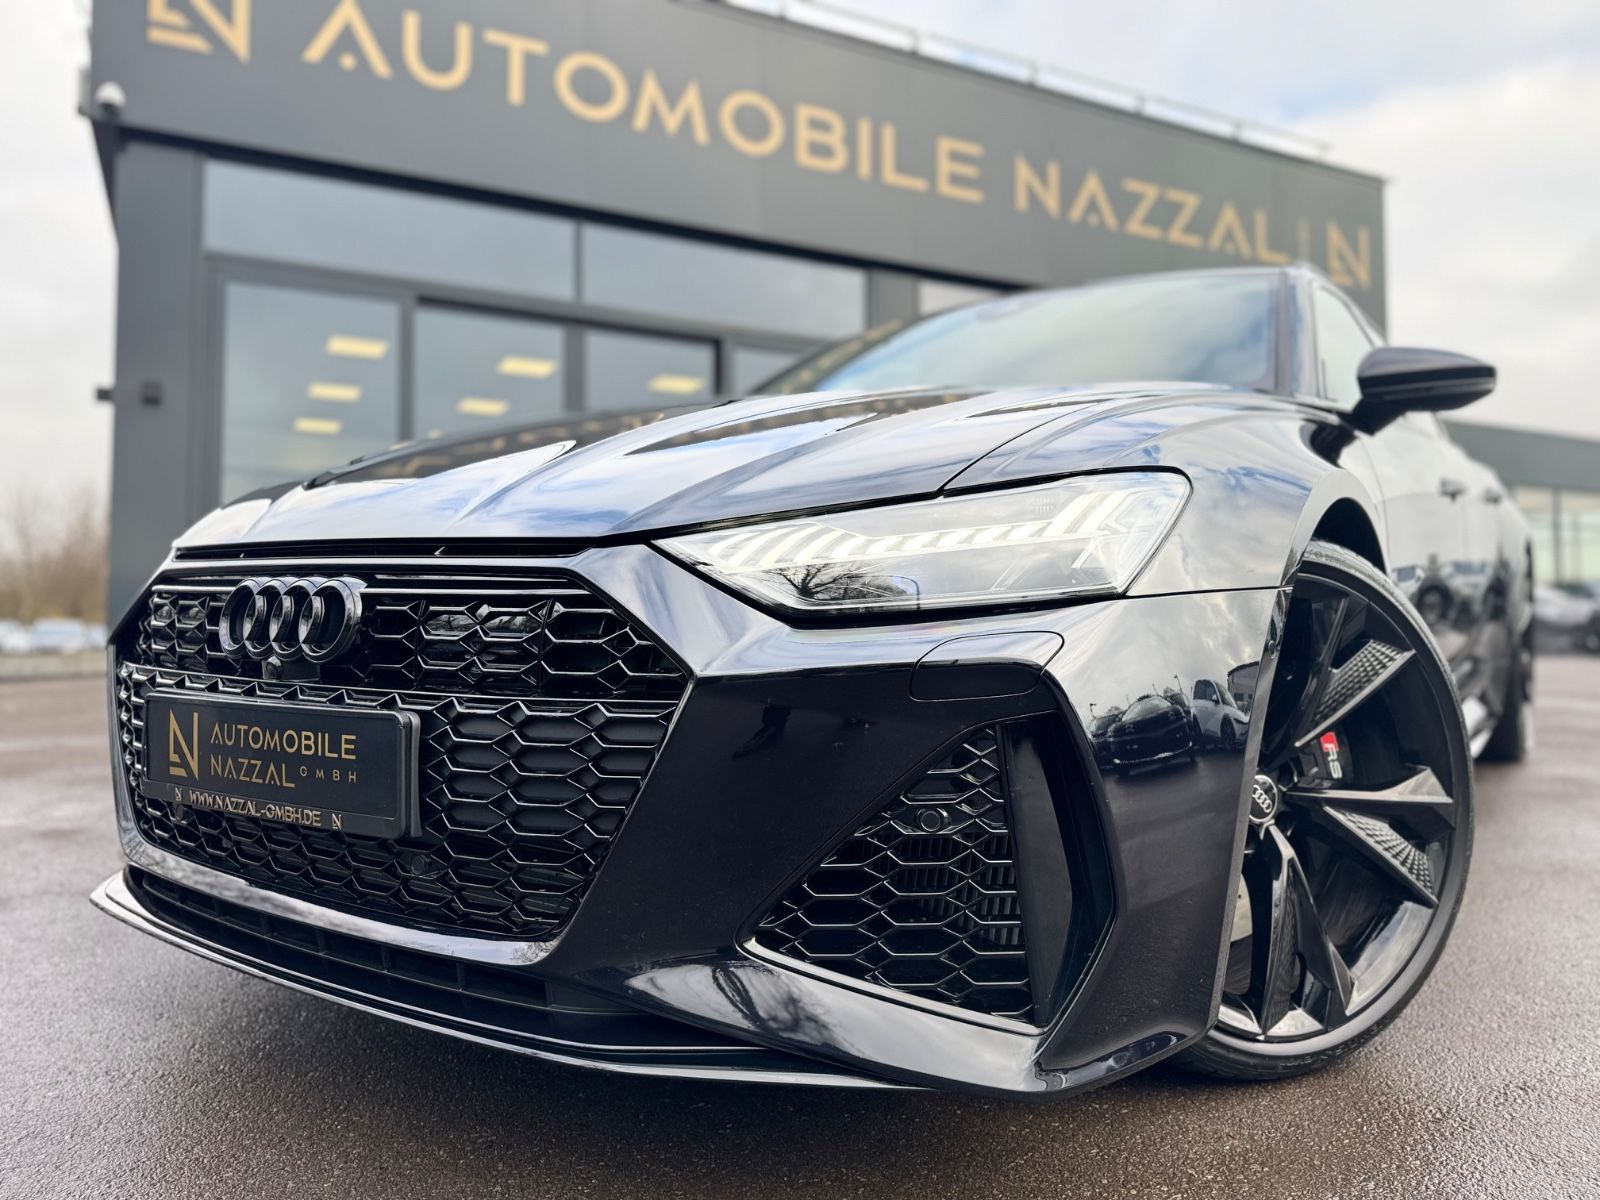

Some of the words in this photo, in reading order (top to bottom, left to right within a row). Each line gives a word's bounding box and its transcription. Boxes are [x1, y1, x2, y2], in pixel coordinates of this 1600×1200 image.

[303, 0, 984, 203] AUTOMOBILE
[1014, 154, 1289, 265] NAZZAL
[210, 722, 357, 760] AUTOMOBILE
[210, 754, 295, 788] NAZZAL
[1323, 742, 1343, 779] RS
